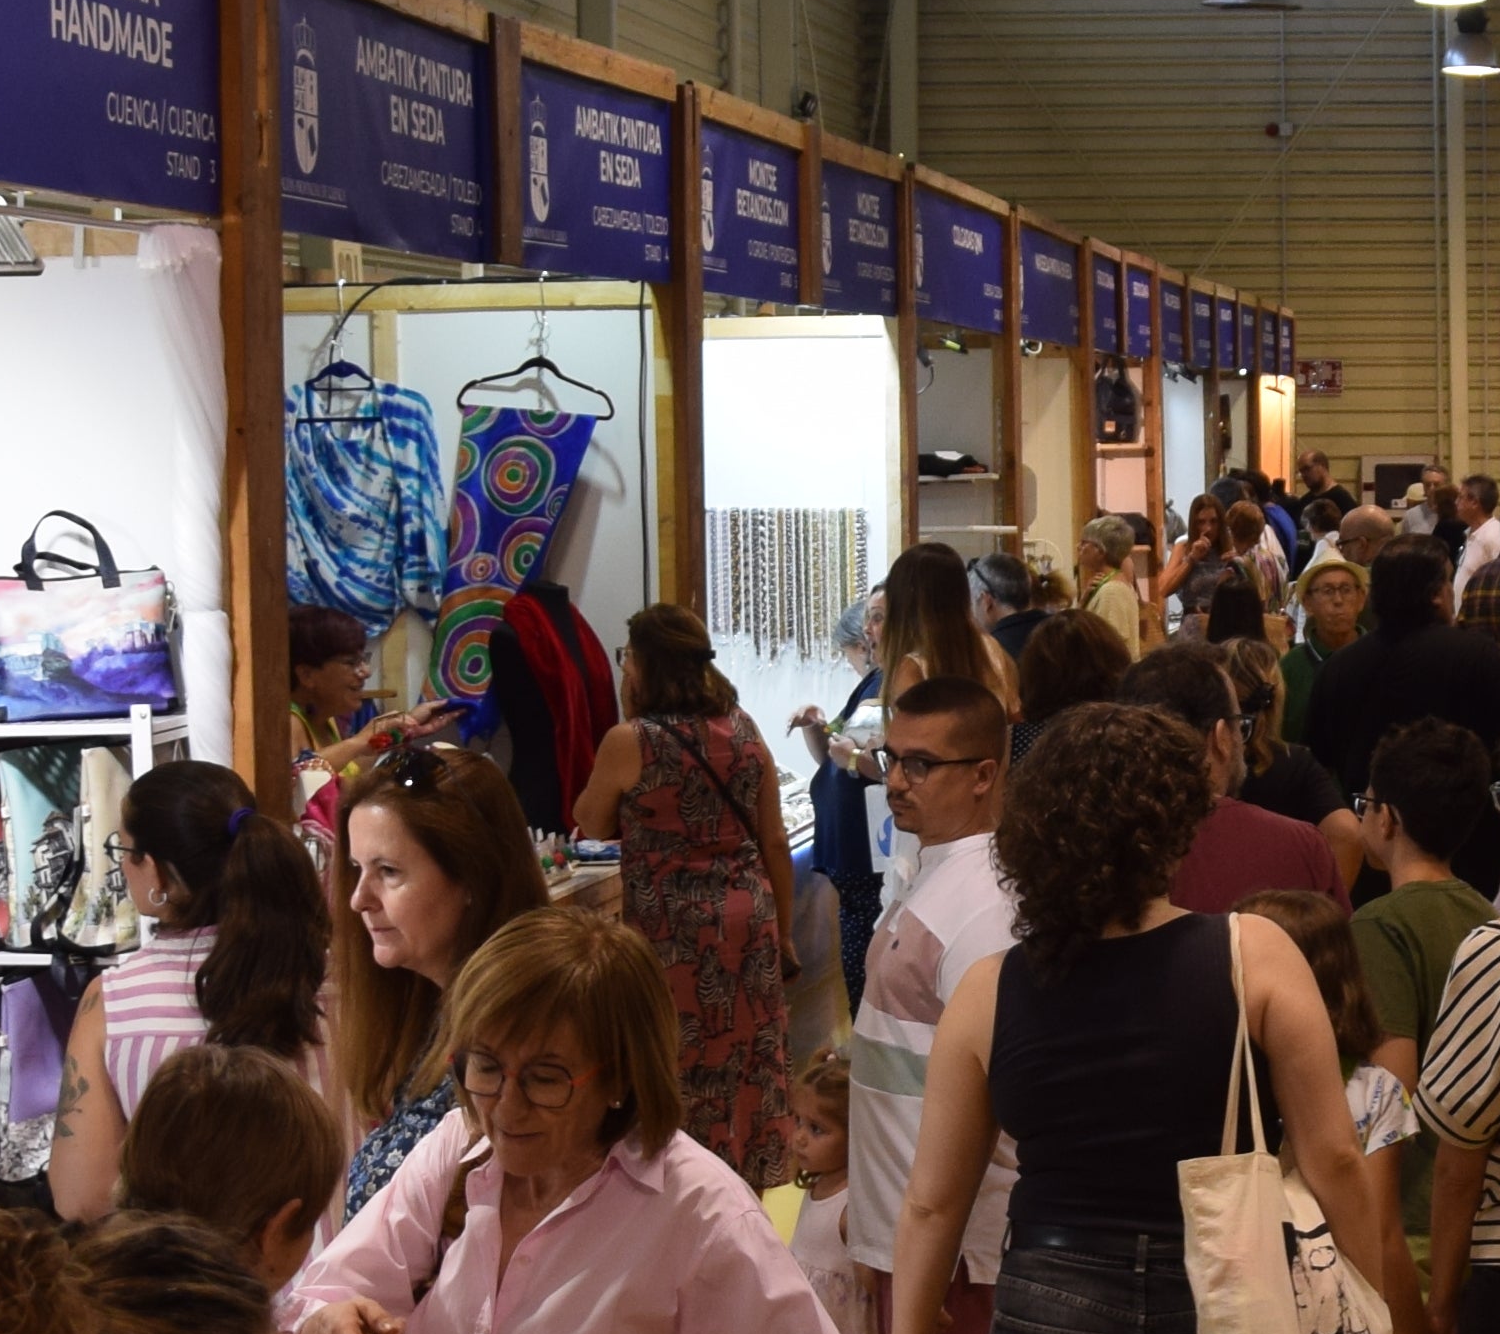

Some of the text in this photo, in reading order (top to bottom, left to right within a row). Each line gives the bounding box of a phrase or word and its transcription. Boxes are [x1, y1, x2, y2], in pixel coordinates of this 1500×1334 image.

[356, 35, 474, 108] AMBATIK PINTURA
[107, 92, 159, 132] CUENCA
[169, 106, 216, 144] CUENCA
[390, 95, 446, 146] EN SEDA
[575, 105, 662, 155] AMBATIK PINTURA
[166, 151, 200, 181] STAND
[600, 150, 642, 189] EN SEDA
[749, 157, 777, 192] MONTSE
